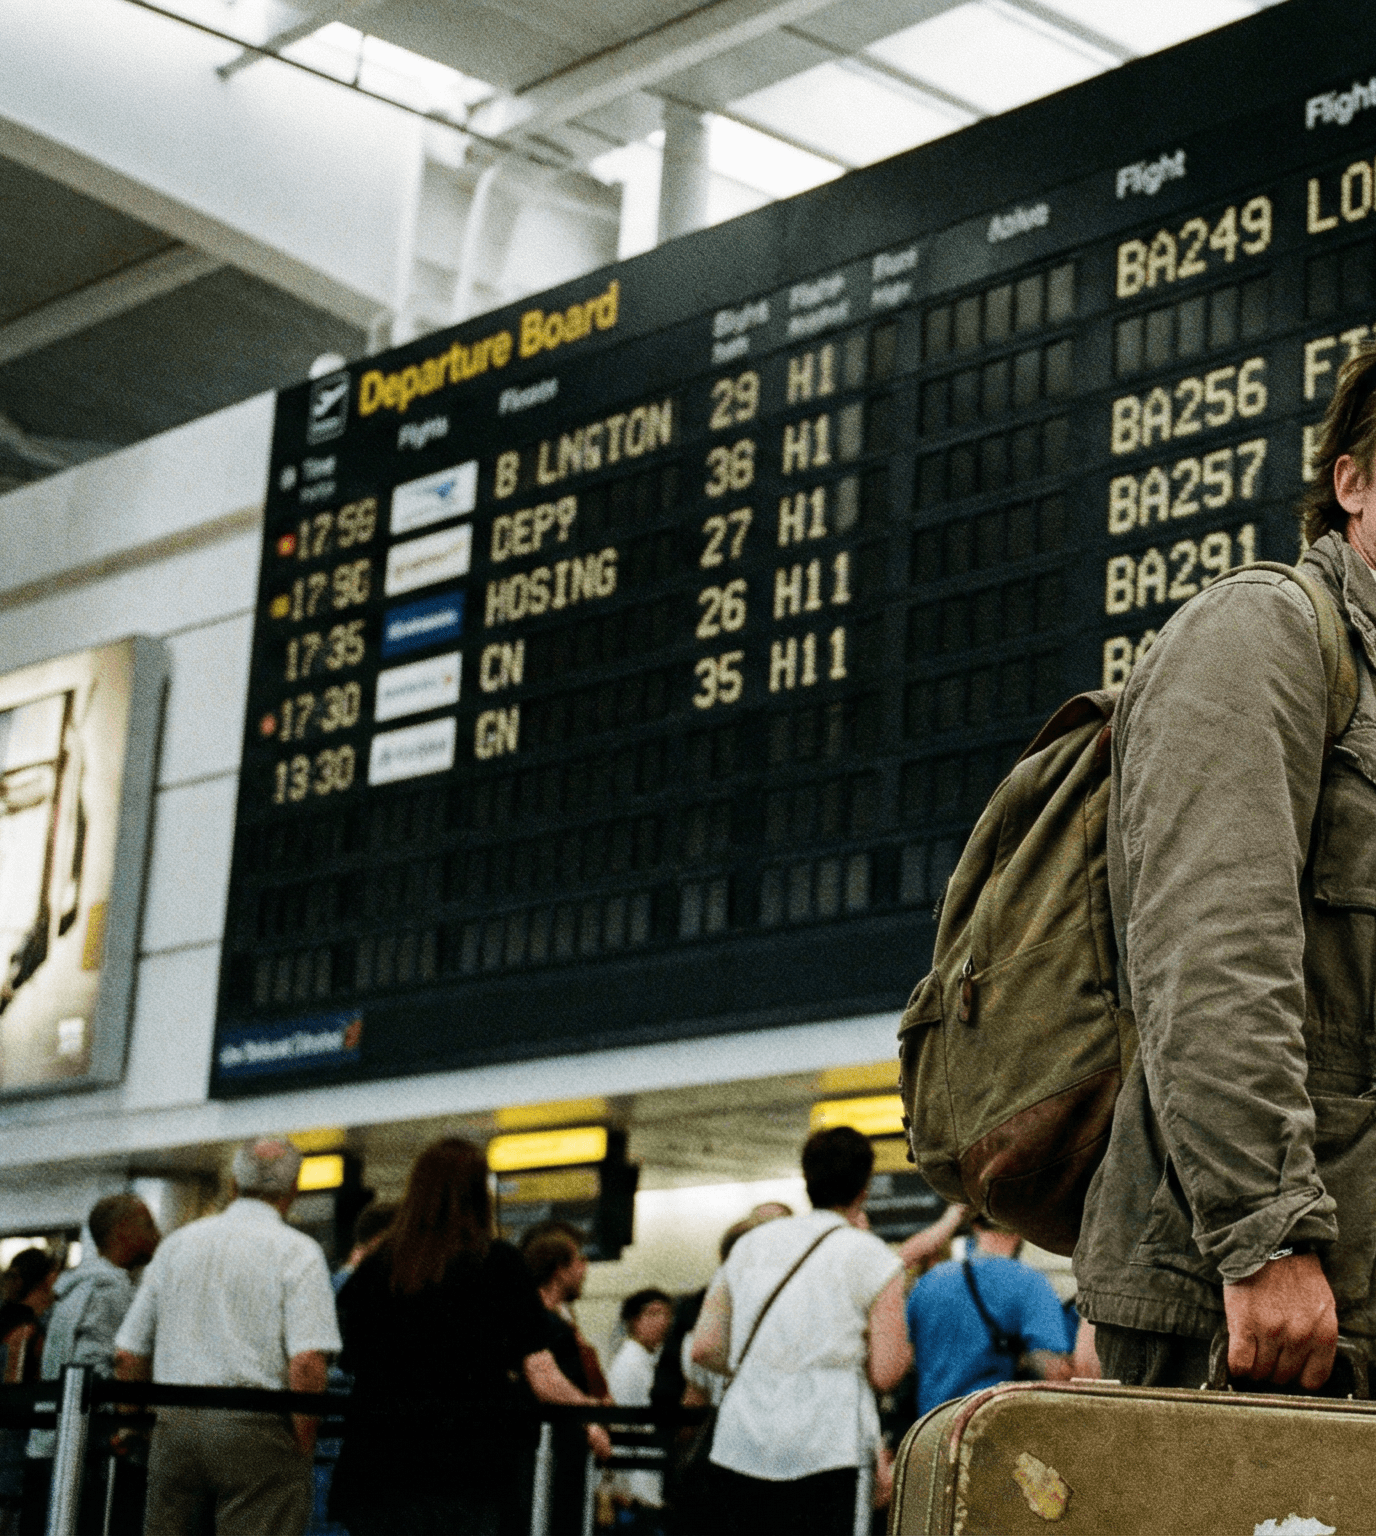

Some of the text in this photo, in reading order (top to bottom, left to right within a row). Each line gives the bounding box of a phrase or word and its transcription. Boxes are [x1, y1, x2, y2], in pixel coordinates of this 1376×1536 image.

[1115, 195, 1273, 299] BA249
[359, 330, 513, 416] Departure
[519, 279, 621, 358] Board
[494, 451, 520, 499] B
[709, 370, 760, 430] 29
[787, 345, 834, 402] H1
[783, 415, 831, 472] H1
[1110, 356, 1269, 456] BA256
[1107, 437, 1268, 535] BA257
[484, 547, 618, 627] HOSING
[700, 507, 753, 568] 27
[778, 487, 827, 545] H1
[1105, 523, 1256, 615] BA291
[695, 578, 747, 639] 26
[693, 650, 744, 709] 35
